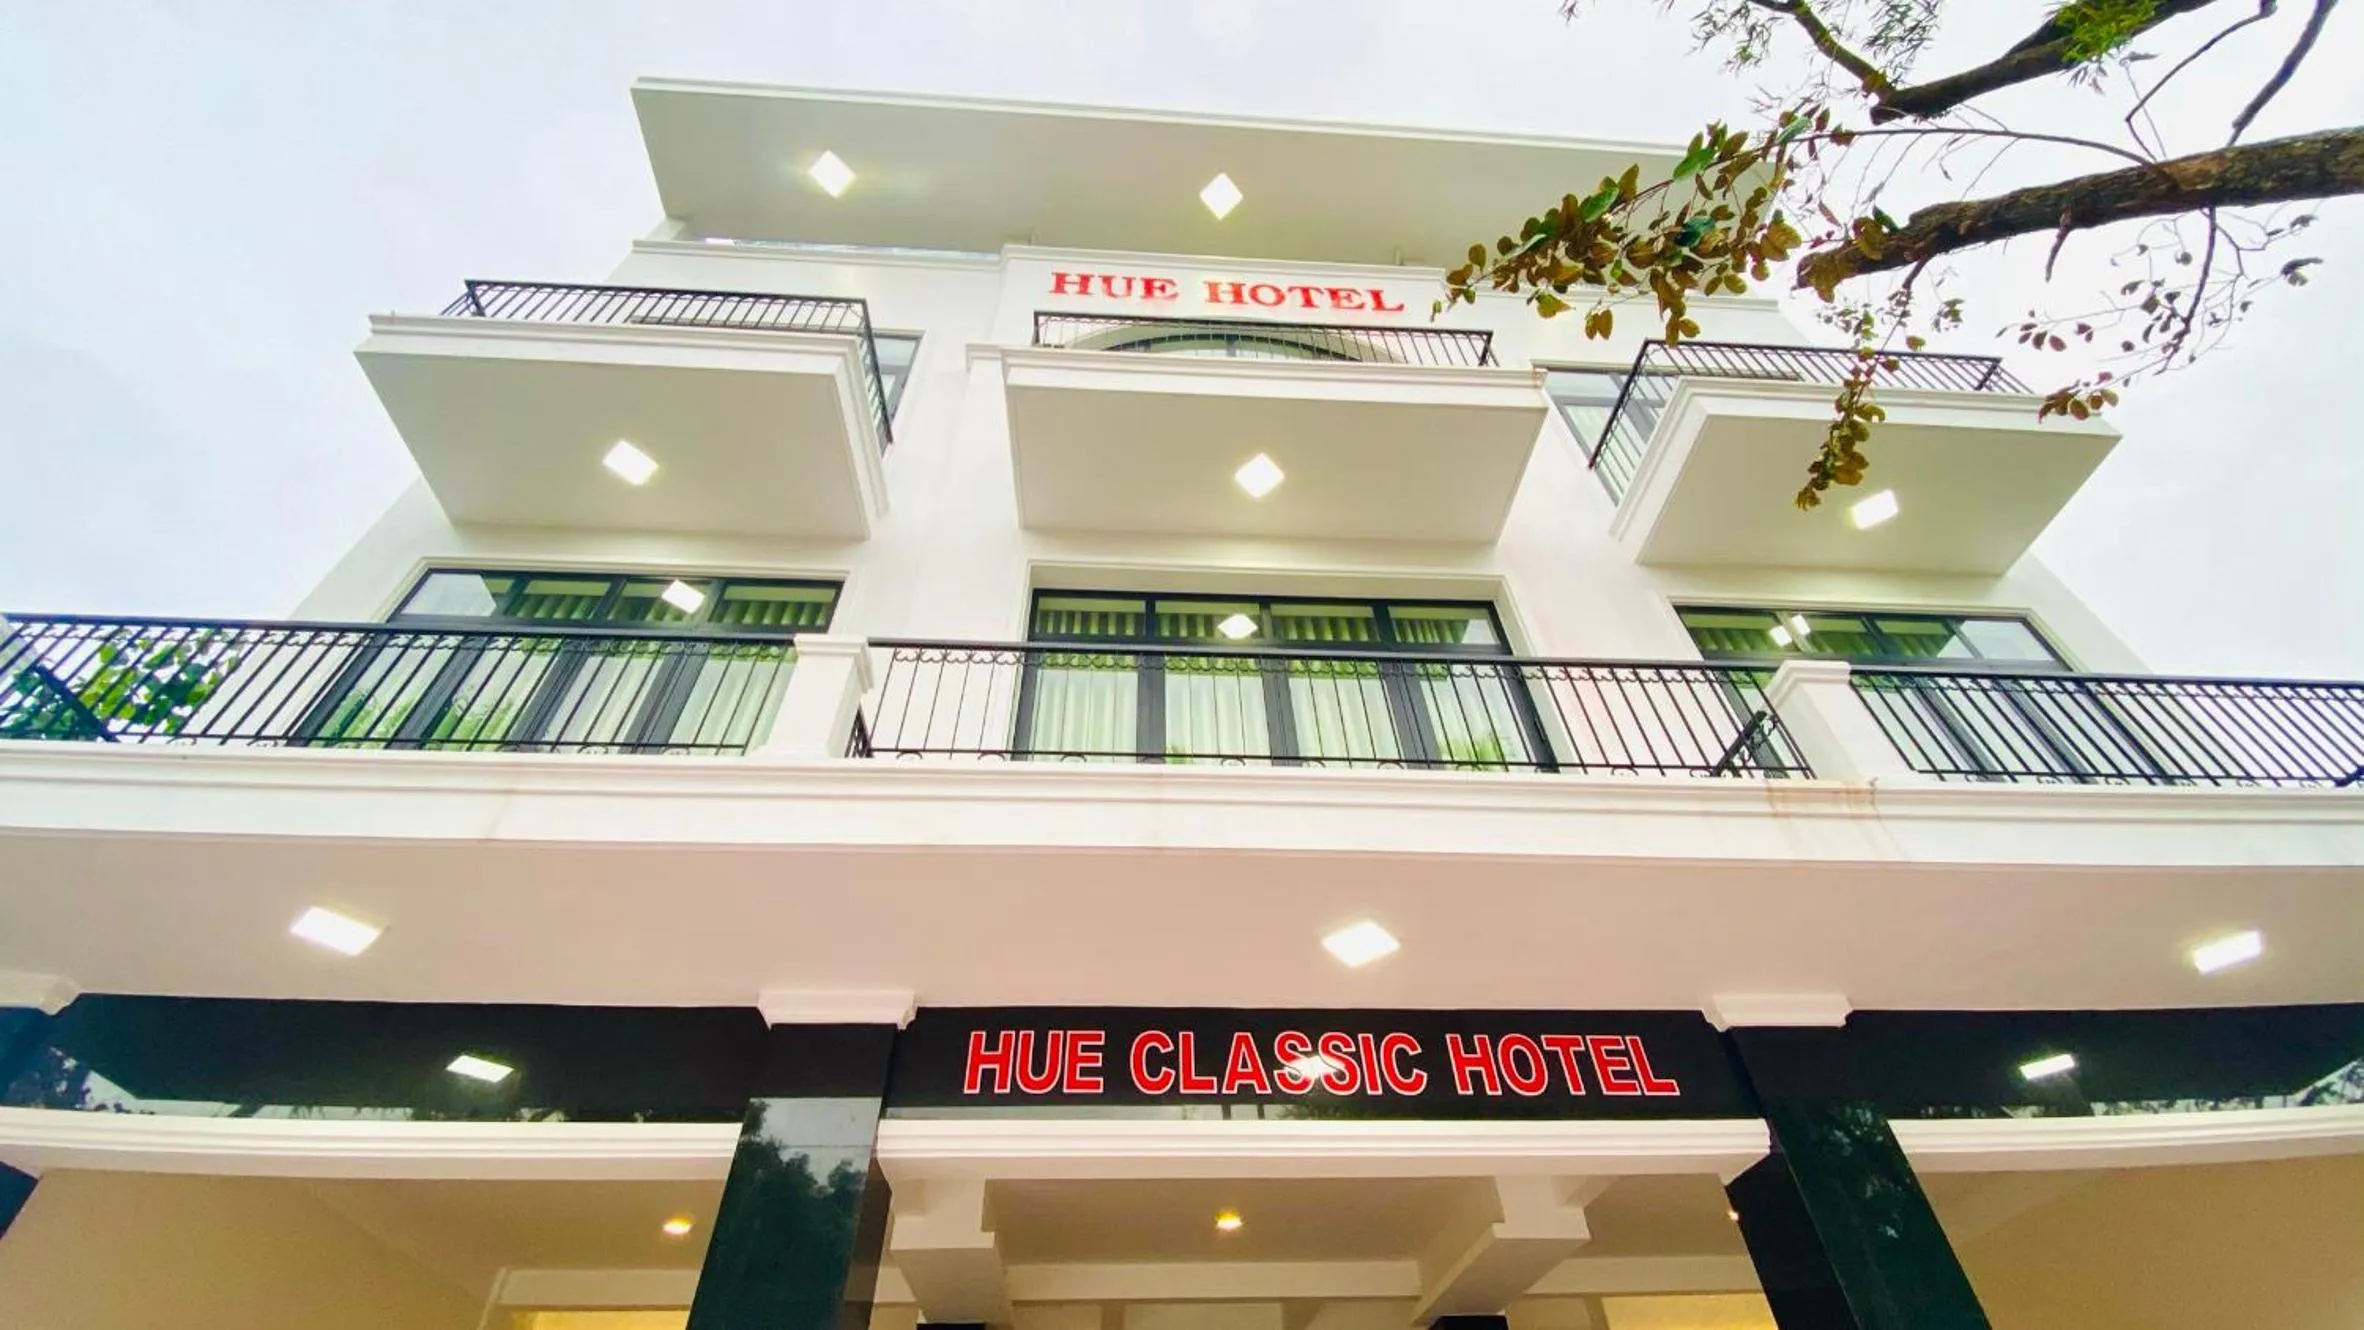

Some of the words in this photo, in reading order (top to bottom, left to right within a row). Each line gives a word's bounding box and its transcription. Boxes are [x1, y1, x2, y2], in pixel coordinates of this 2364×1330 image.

[1048, 272, 1181, 301] HUE
[1203, 280, 1405, 312] HOTEL
[963, 1030, 1106, 1095] HUE
[1129, 1031, 1428, 1095] CLASSIC
[1445, 1032, 1681, 1096] HOTEL
